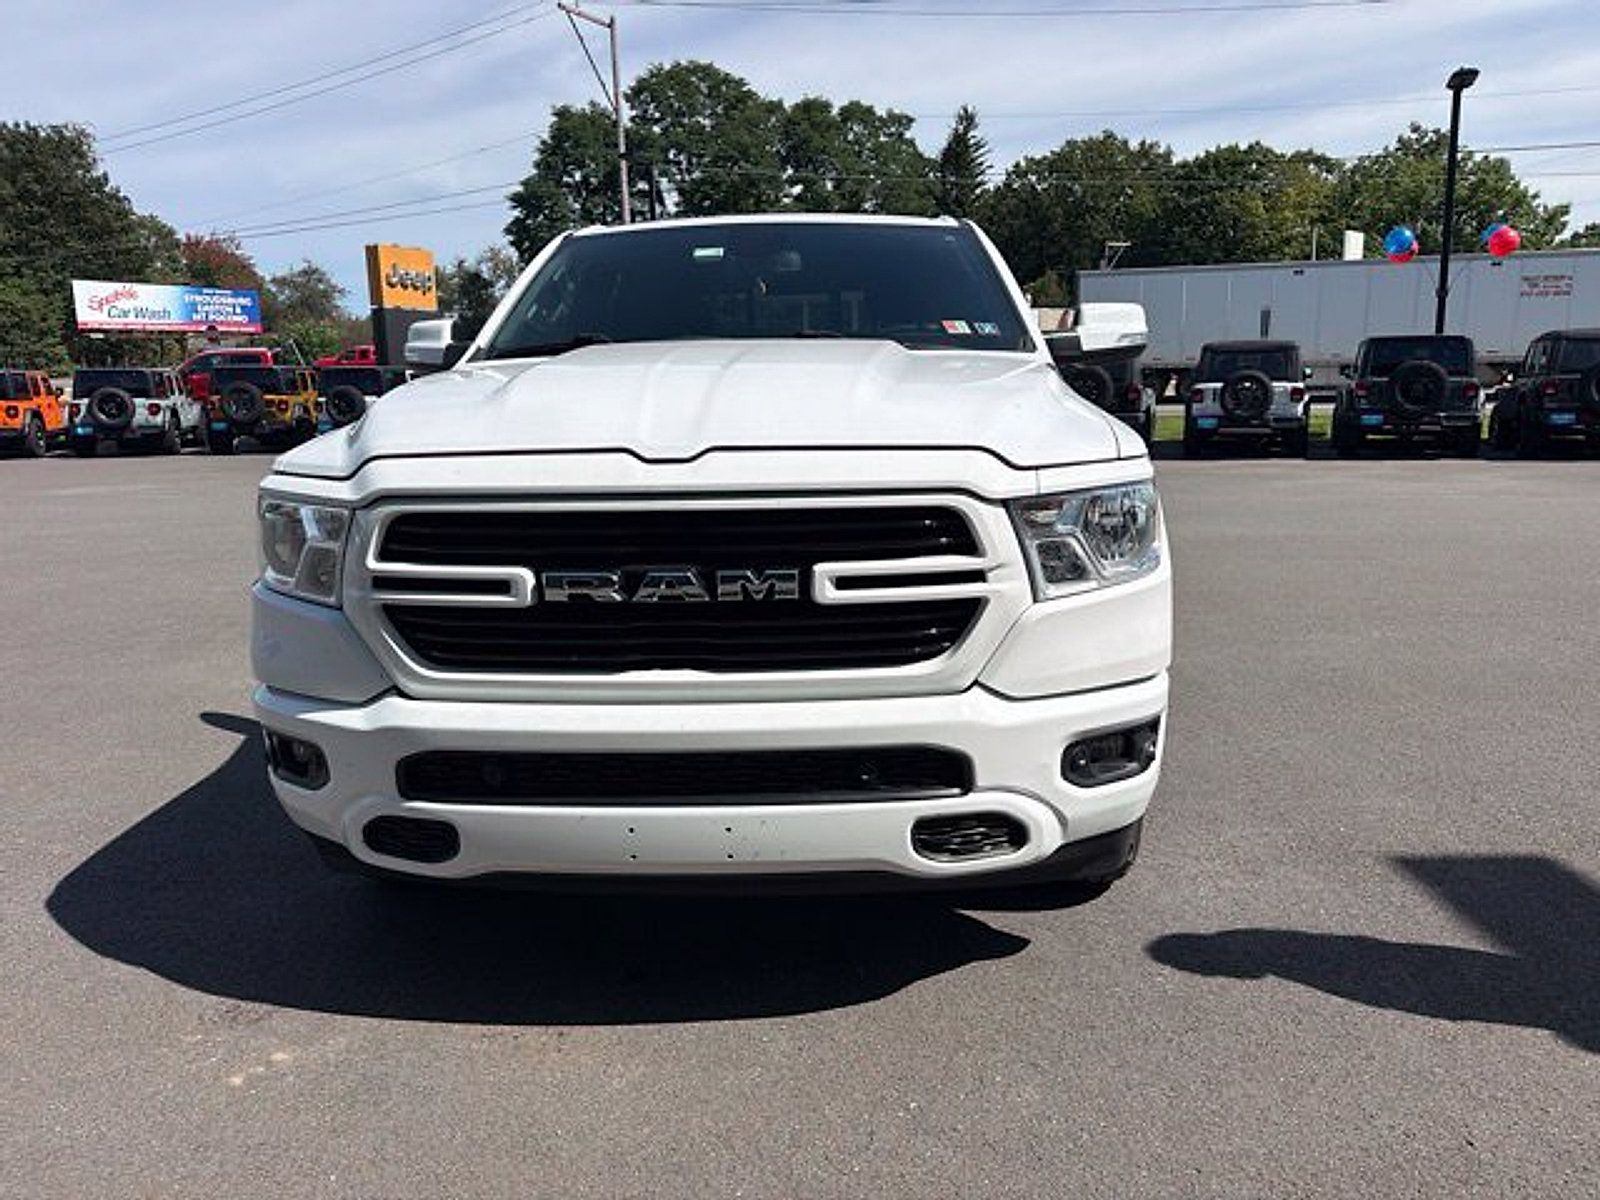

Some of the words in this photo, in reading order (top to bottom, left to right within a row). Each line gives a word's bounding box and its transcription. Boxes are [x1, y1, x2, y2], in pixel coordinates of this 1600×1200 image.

[386, 264, 434, 292] Jeep
[108, 305, 131, 318] Car
[132, 306, 171, 320] Wash
[543, 568, 800, 601] RAM
